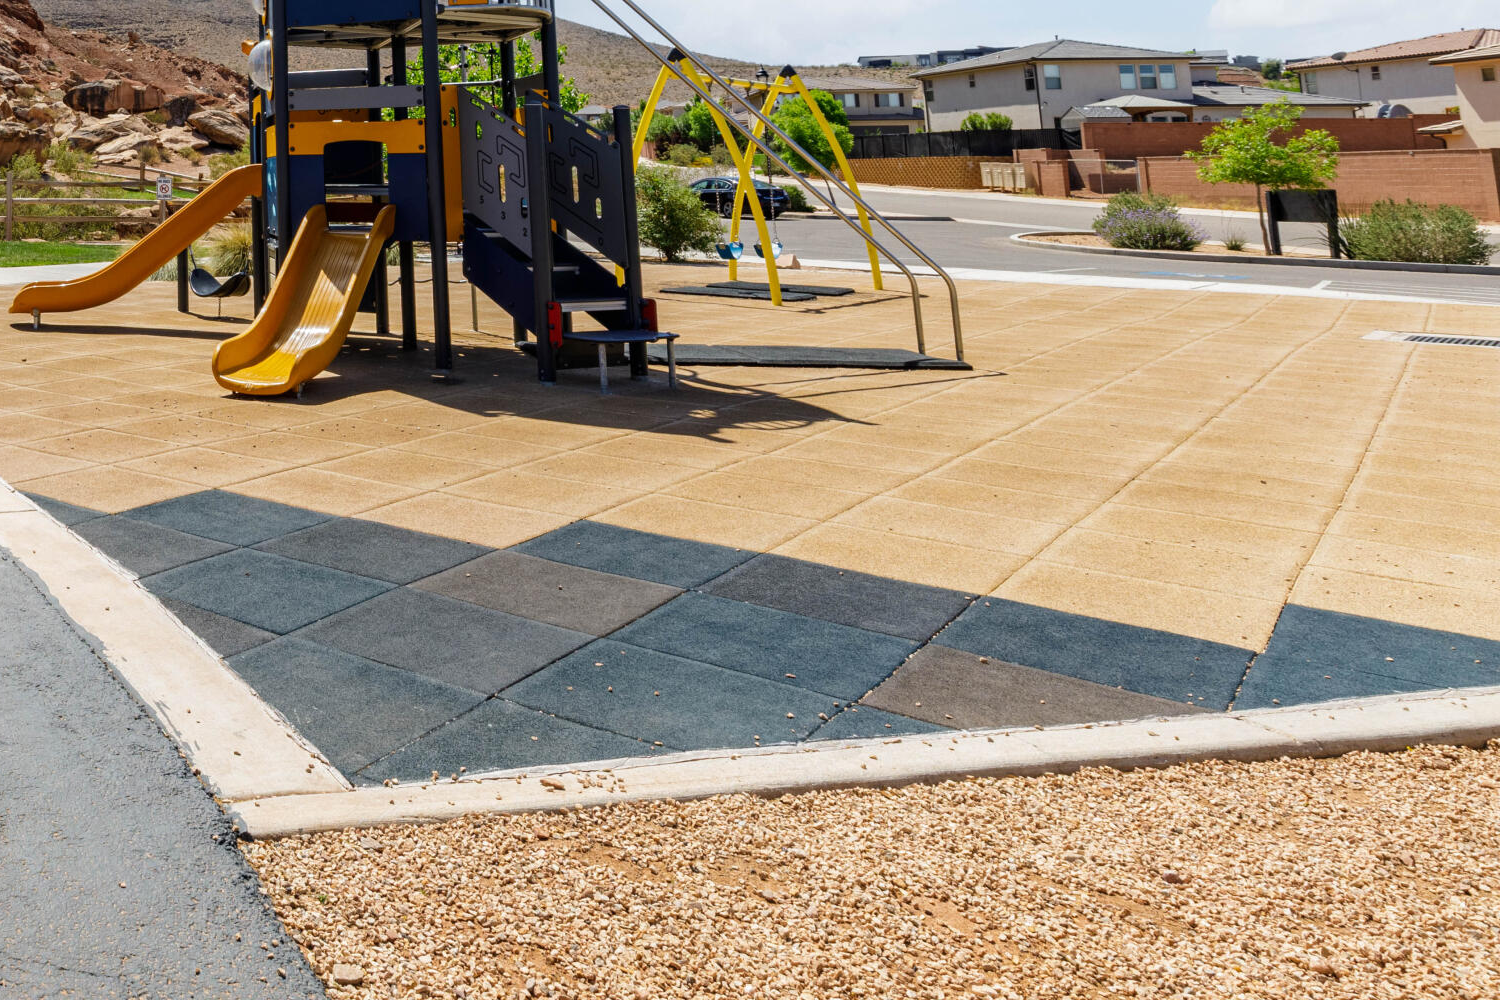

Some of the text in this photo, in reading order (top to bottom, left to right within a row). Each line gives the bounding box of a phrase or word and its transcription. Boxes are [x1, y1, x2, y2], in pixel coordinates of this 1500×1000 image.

[479, 195, 485, 204] 5
[501, 211, 506, 220] 3
[522, 227, 528, 237] 2
